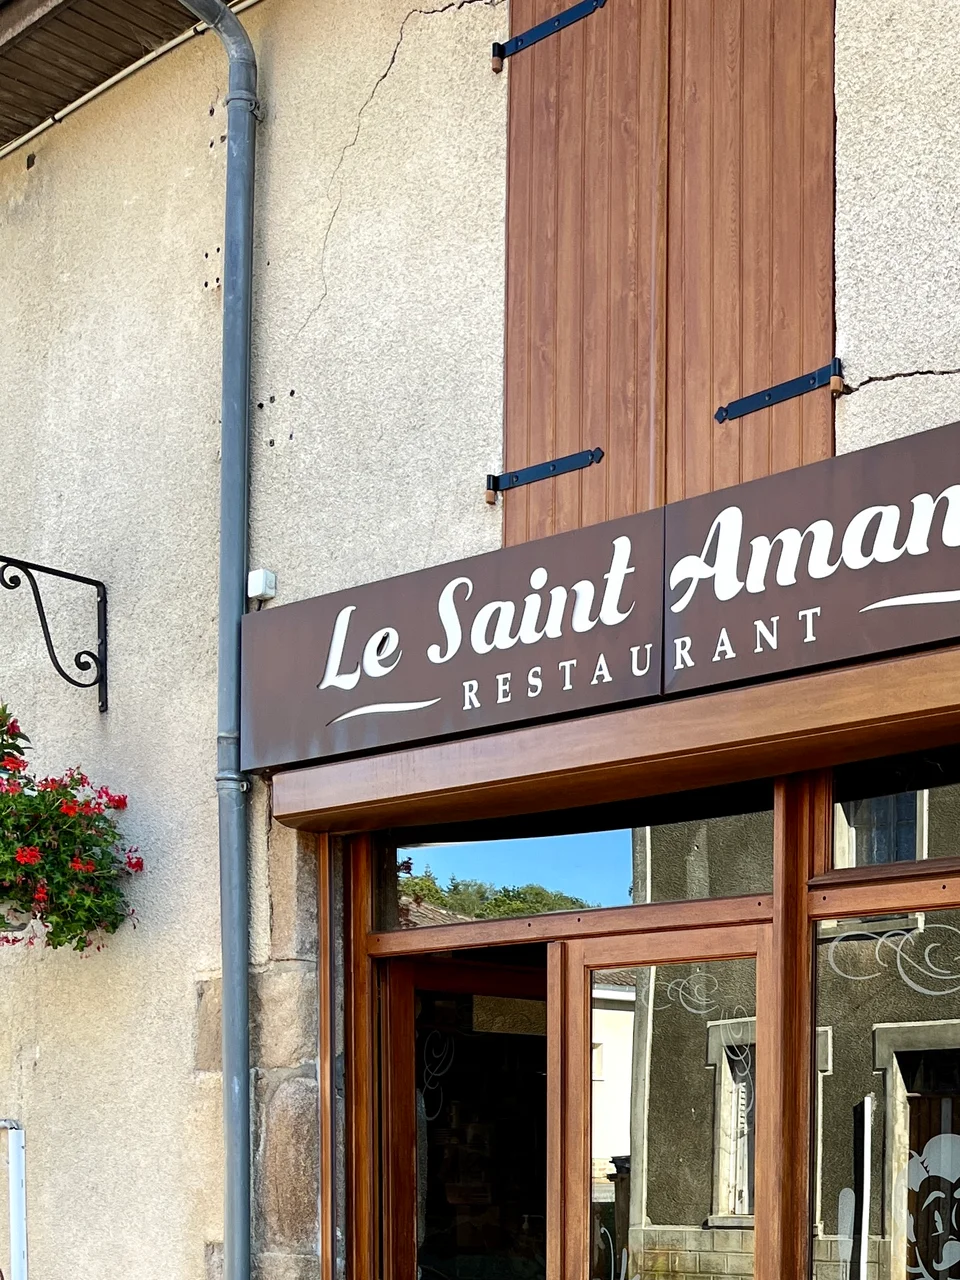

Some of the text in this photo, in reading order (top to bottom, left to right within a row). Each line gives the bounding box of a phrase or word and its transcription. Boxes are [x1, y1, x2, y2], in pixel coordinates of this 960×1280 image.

[317, 604, 403, 692] Le
[426, 535, 636, 664] Saint
[462, 606, 822, 711] RESTAURANT
